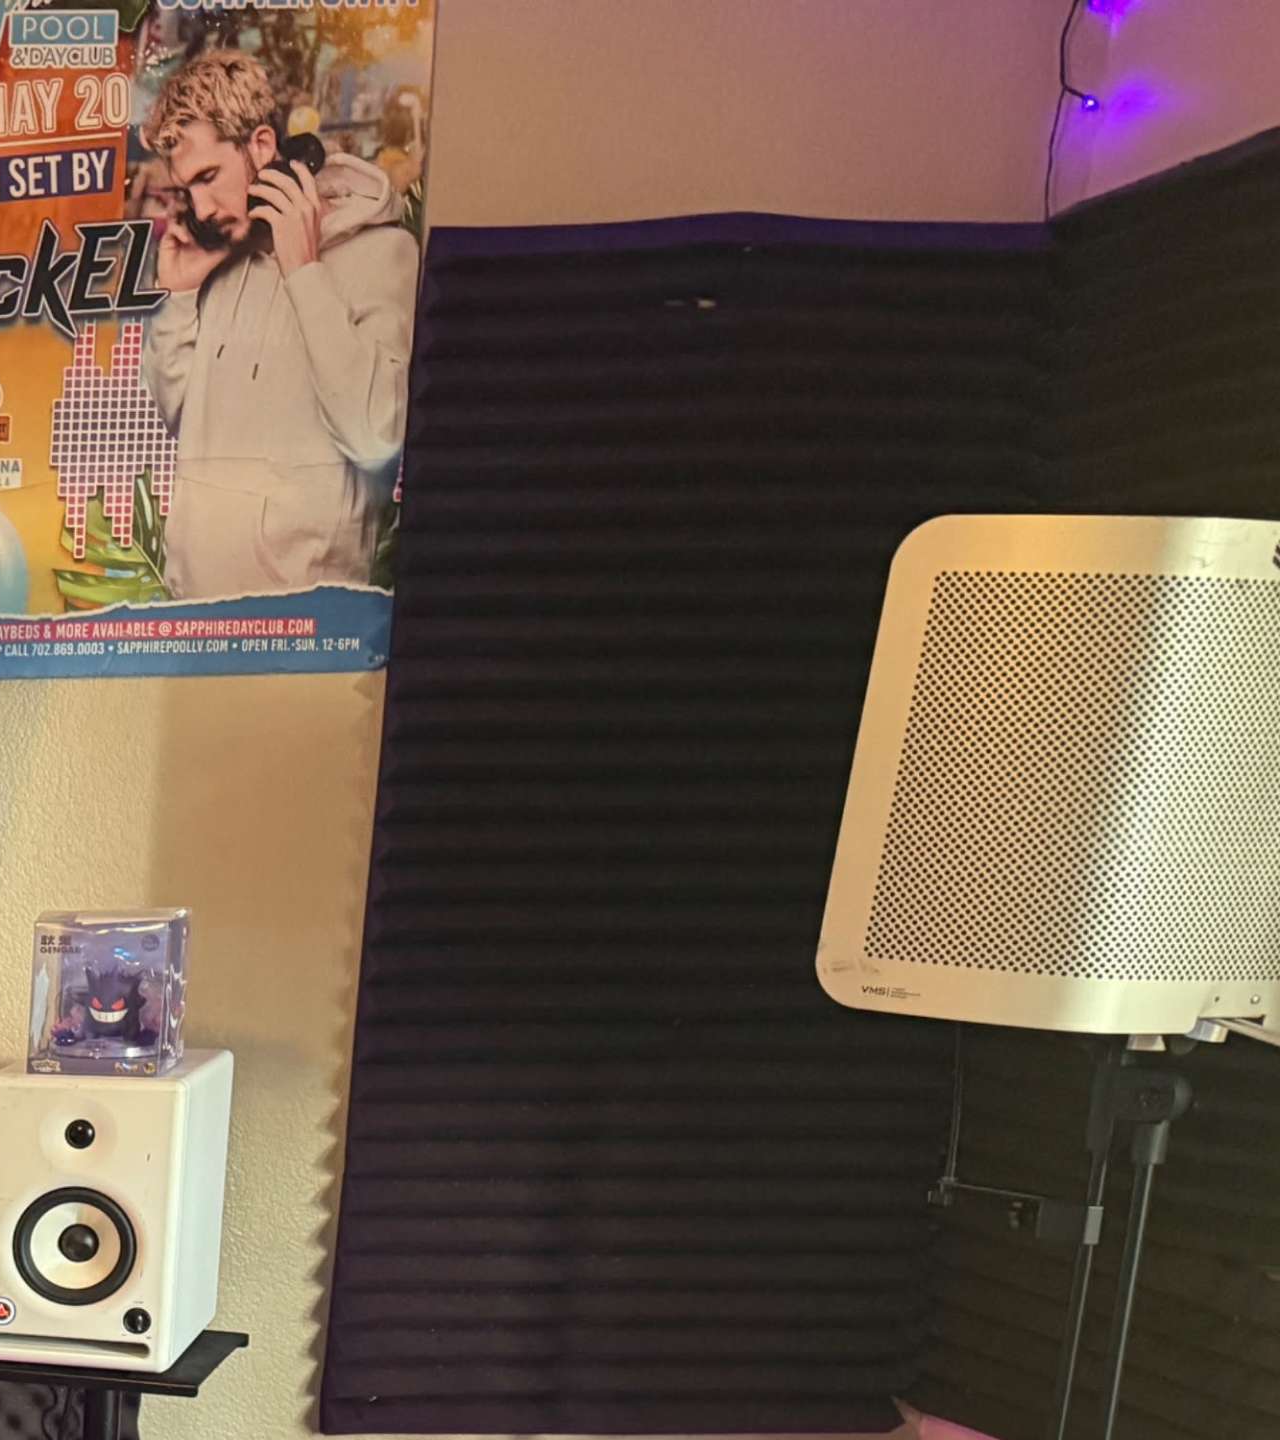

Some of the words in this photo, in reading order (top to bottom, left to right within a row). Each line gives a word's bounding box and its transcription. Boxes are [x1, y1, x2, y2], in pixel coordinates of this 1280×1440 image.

[22, 16, 104, 40] POOL
[77, 74, 130, 127] 20
[8, 156, 59, 197] SET
[71, 150, 109, 191] BY
[43, 625, 51, 638] &
[55, 623, 89, 638] MORE
[92, 621, 154, 638] AVAILABLE
[158, 621, 172, 637] @
[175, 619, 314, 636] SAPPHIREDAYCLUB.COM
[4, 643, 29, 657] CALL
[31, 641, 105, 657] 702.869.0003
[117, 639, 228, 656] SAPPHIREPOOLLV.COM
[242, 638, 268, 653] OPEN
[322, 637, 360, 652] 12-6PM
[861, 985, 886, 996] VMS
